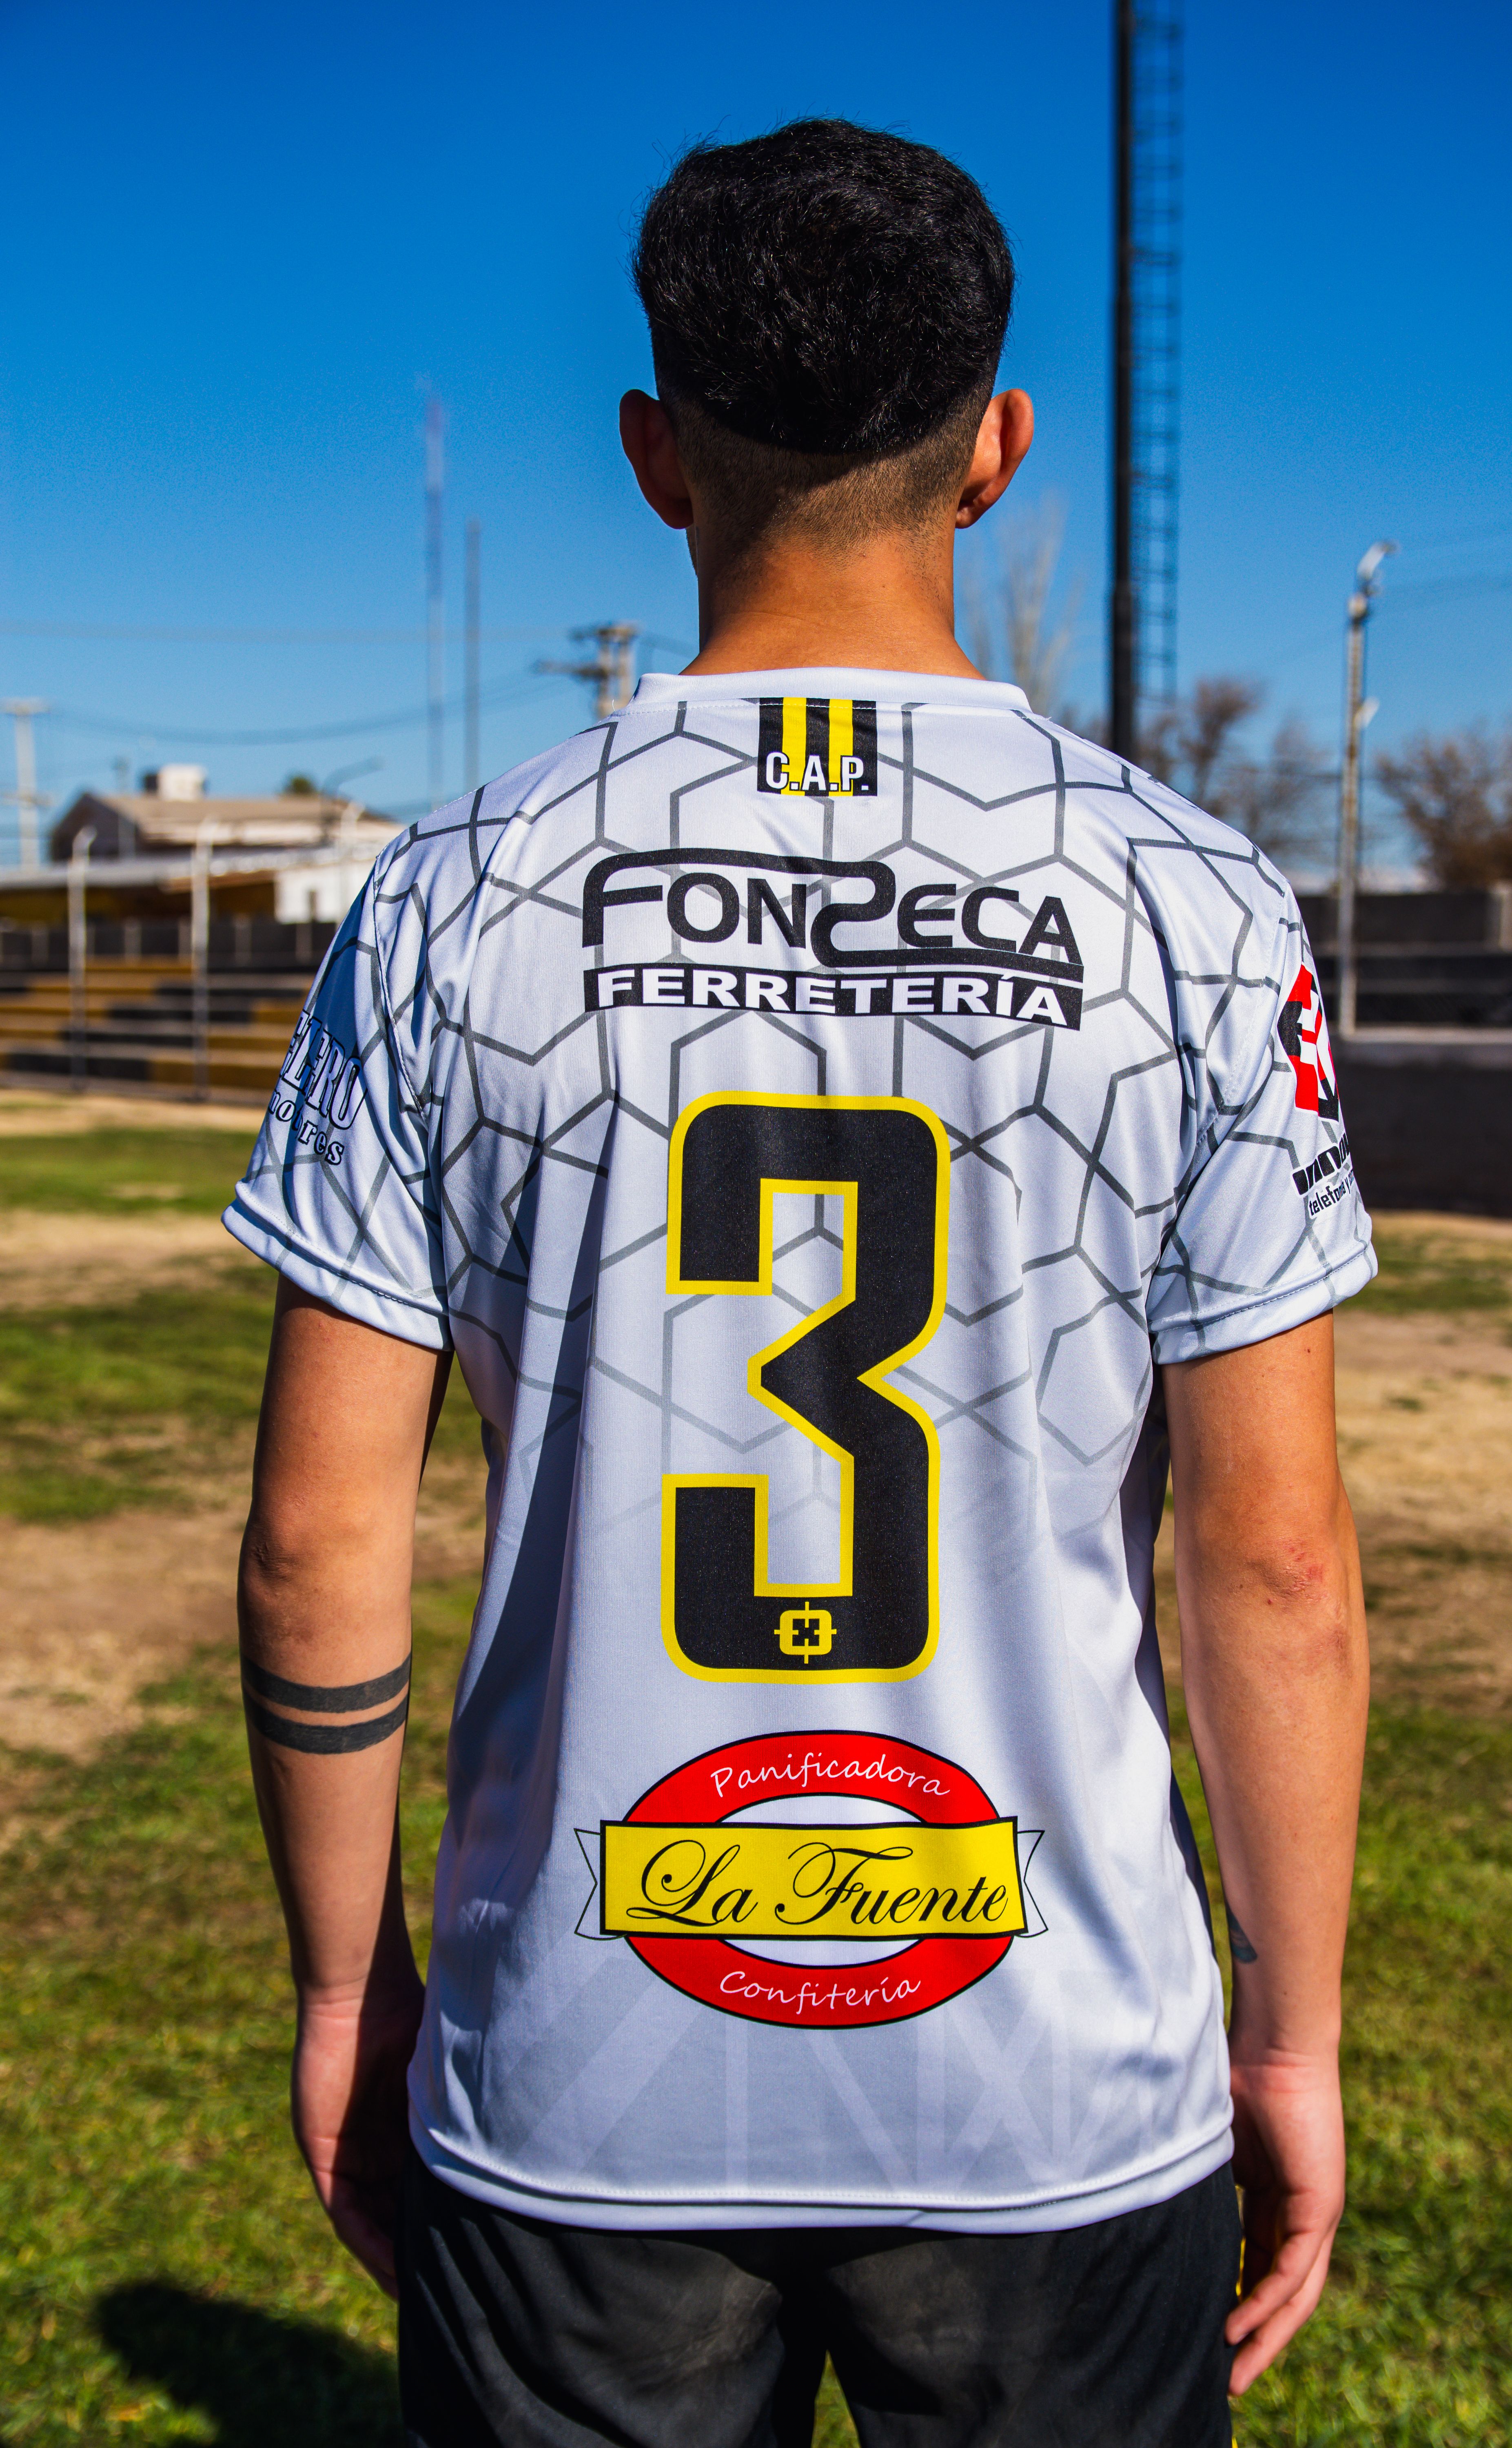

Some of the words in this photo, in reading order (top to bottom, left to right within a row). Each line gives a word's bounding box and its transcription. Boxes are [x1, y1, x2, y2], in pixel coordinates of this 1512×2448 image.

[765, 751, 869, 791] C.A.P.
[582, 847, 1084, 983] FONSECA
[598, 968, 1068, 1026] FERRETERÍA
[662, 1090, 951, 1684] 3
[710, 1752, 951, 1798] Panificadora
[626, 1839, 758, 1927] La
[774, 1842, 1009, 1925] Fuente
[720, 1970, 921, 2014] Confitería
